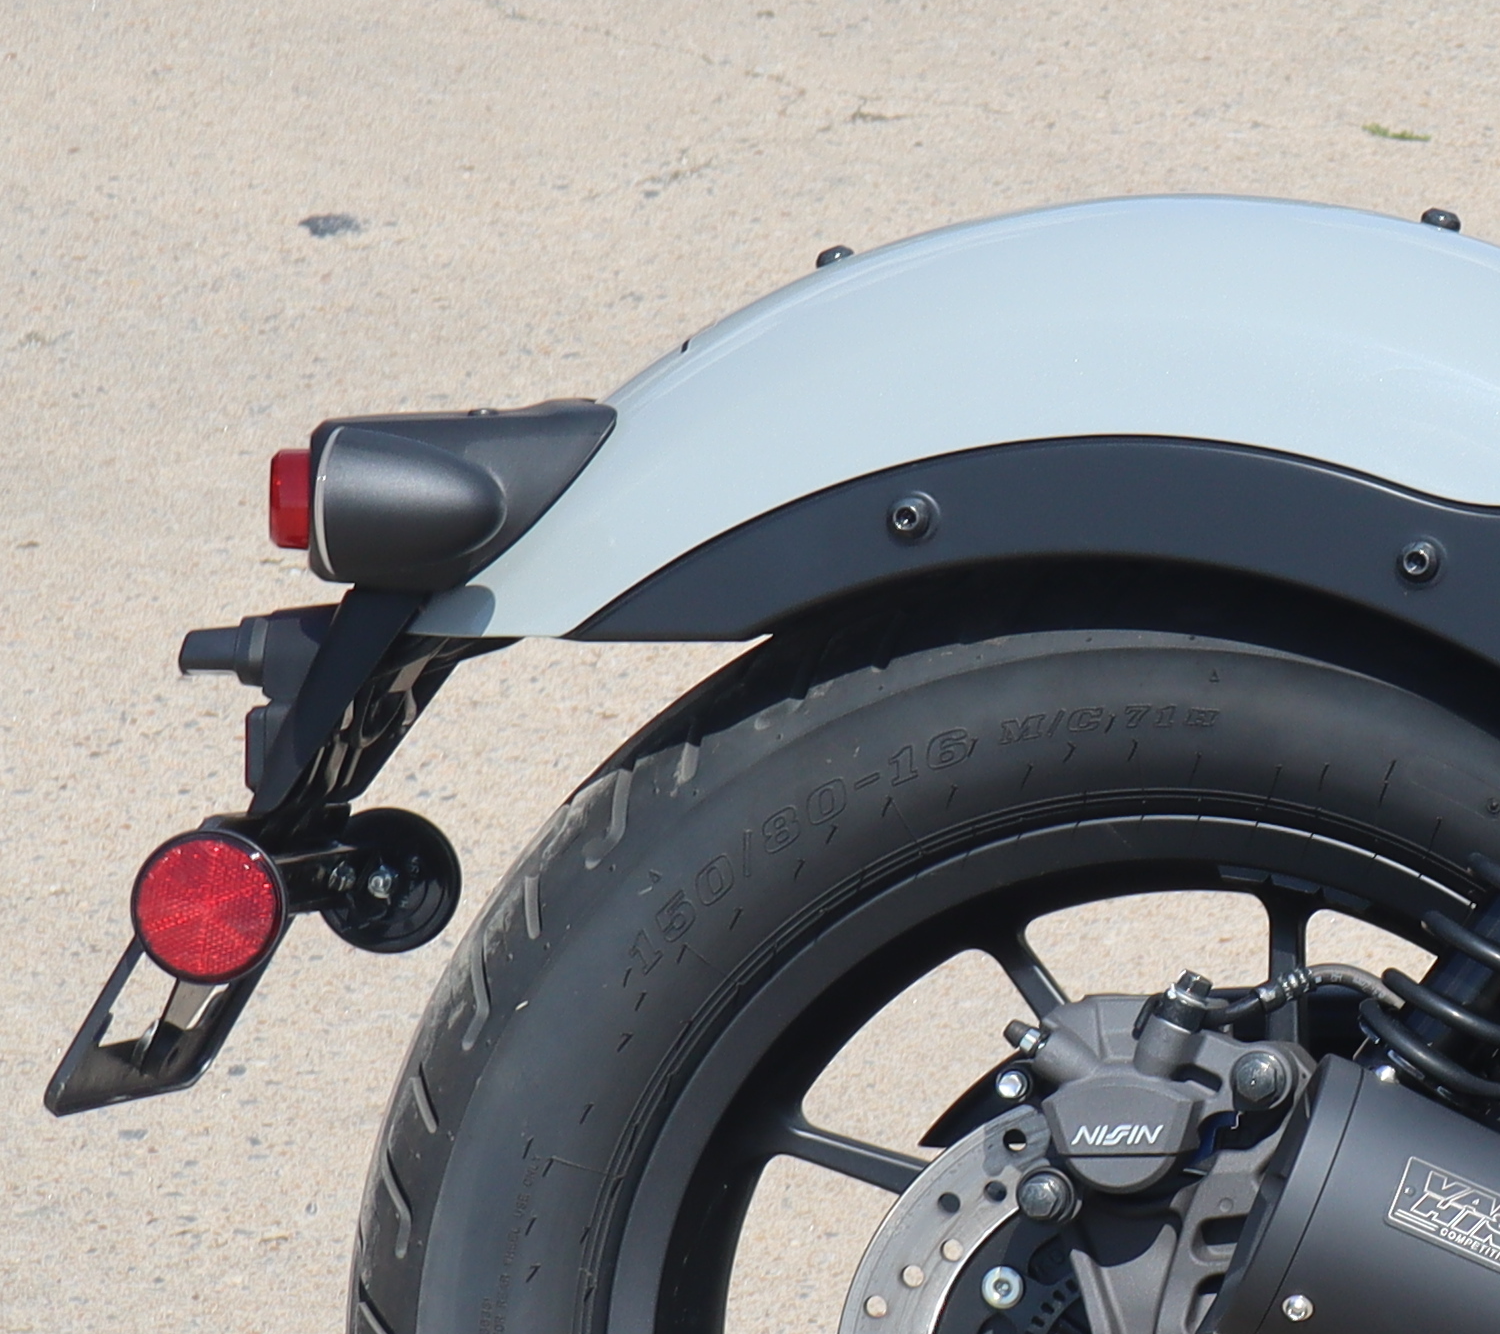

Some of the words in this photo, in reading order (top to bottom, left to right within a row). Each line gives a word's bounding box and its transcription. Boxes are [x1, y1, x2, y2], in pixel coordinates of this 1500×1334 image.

[630, 728, 971, 978] 150/80-16
[1000, 706, 1104, 745] M/C
[1124, 704, 1220, 732] 71H
[1070, 1124, 1165, 1146] NISIN
